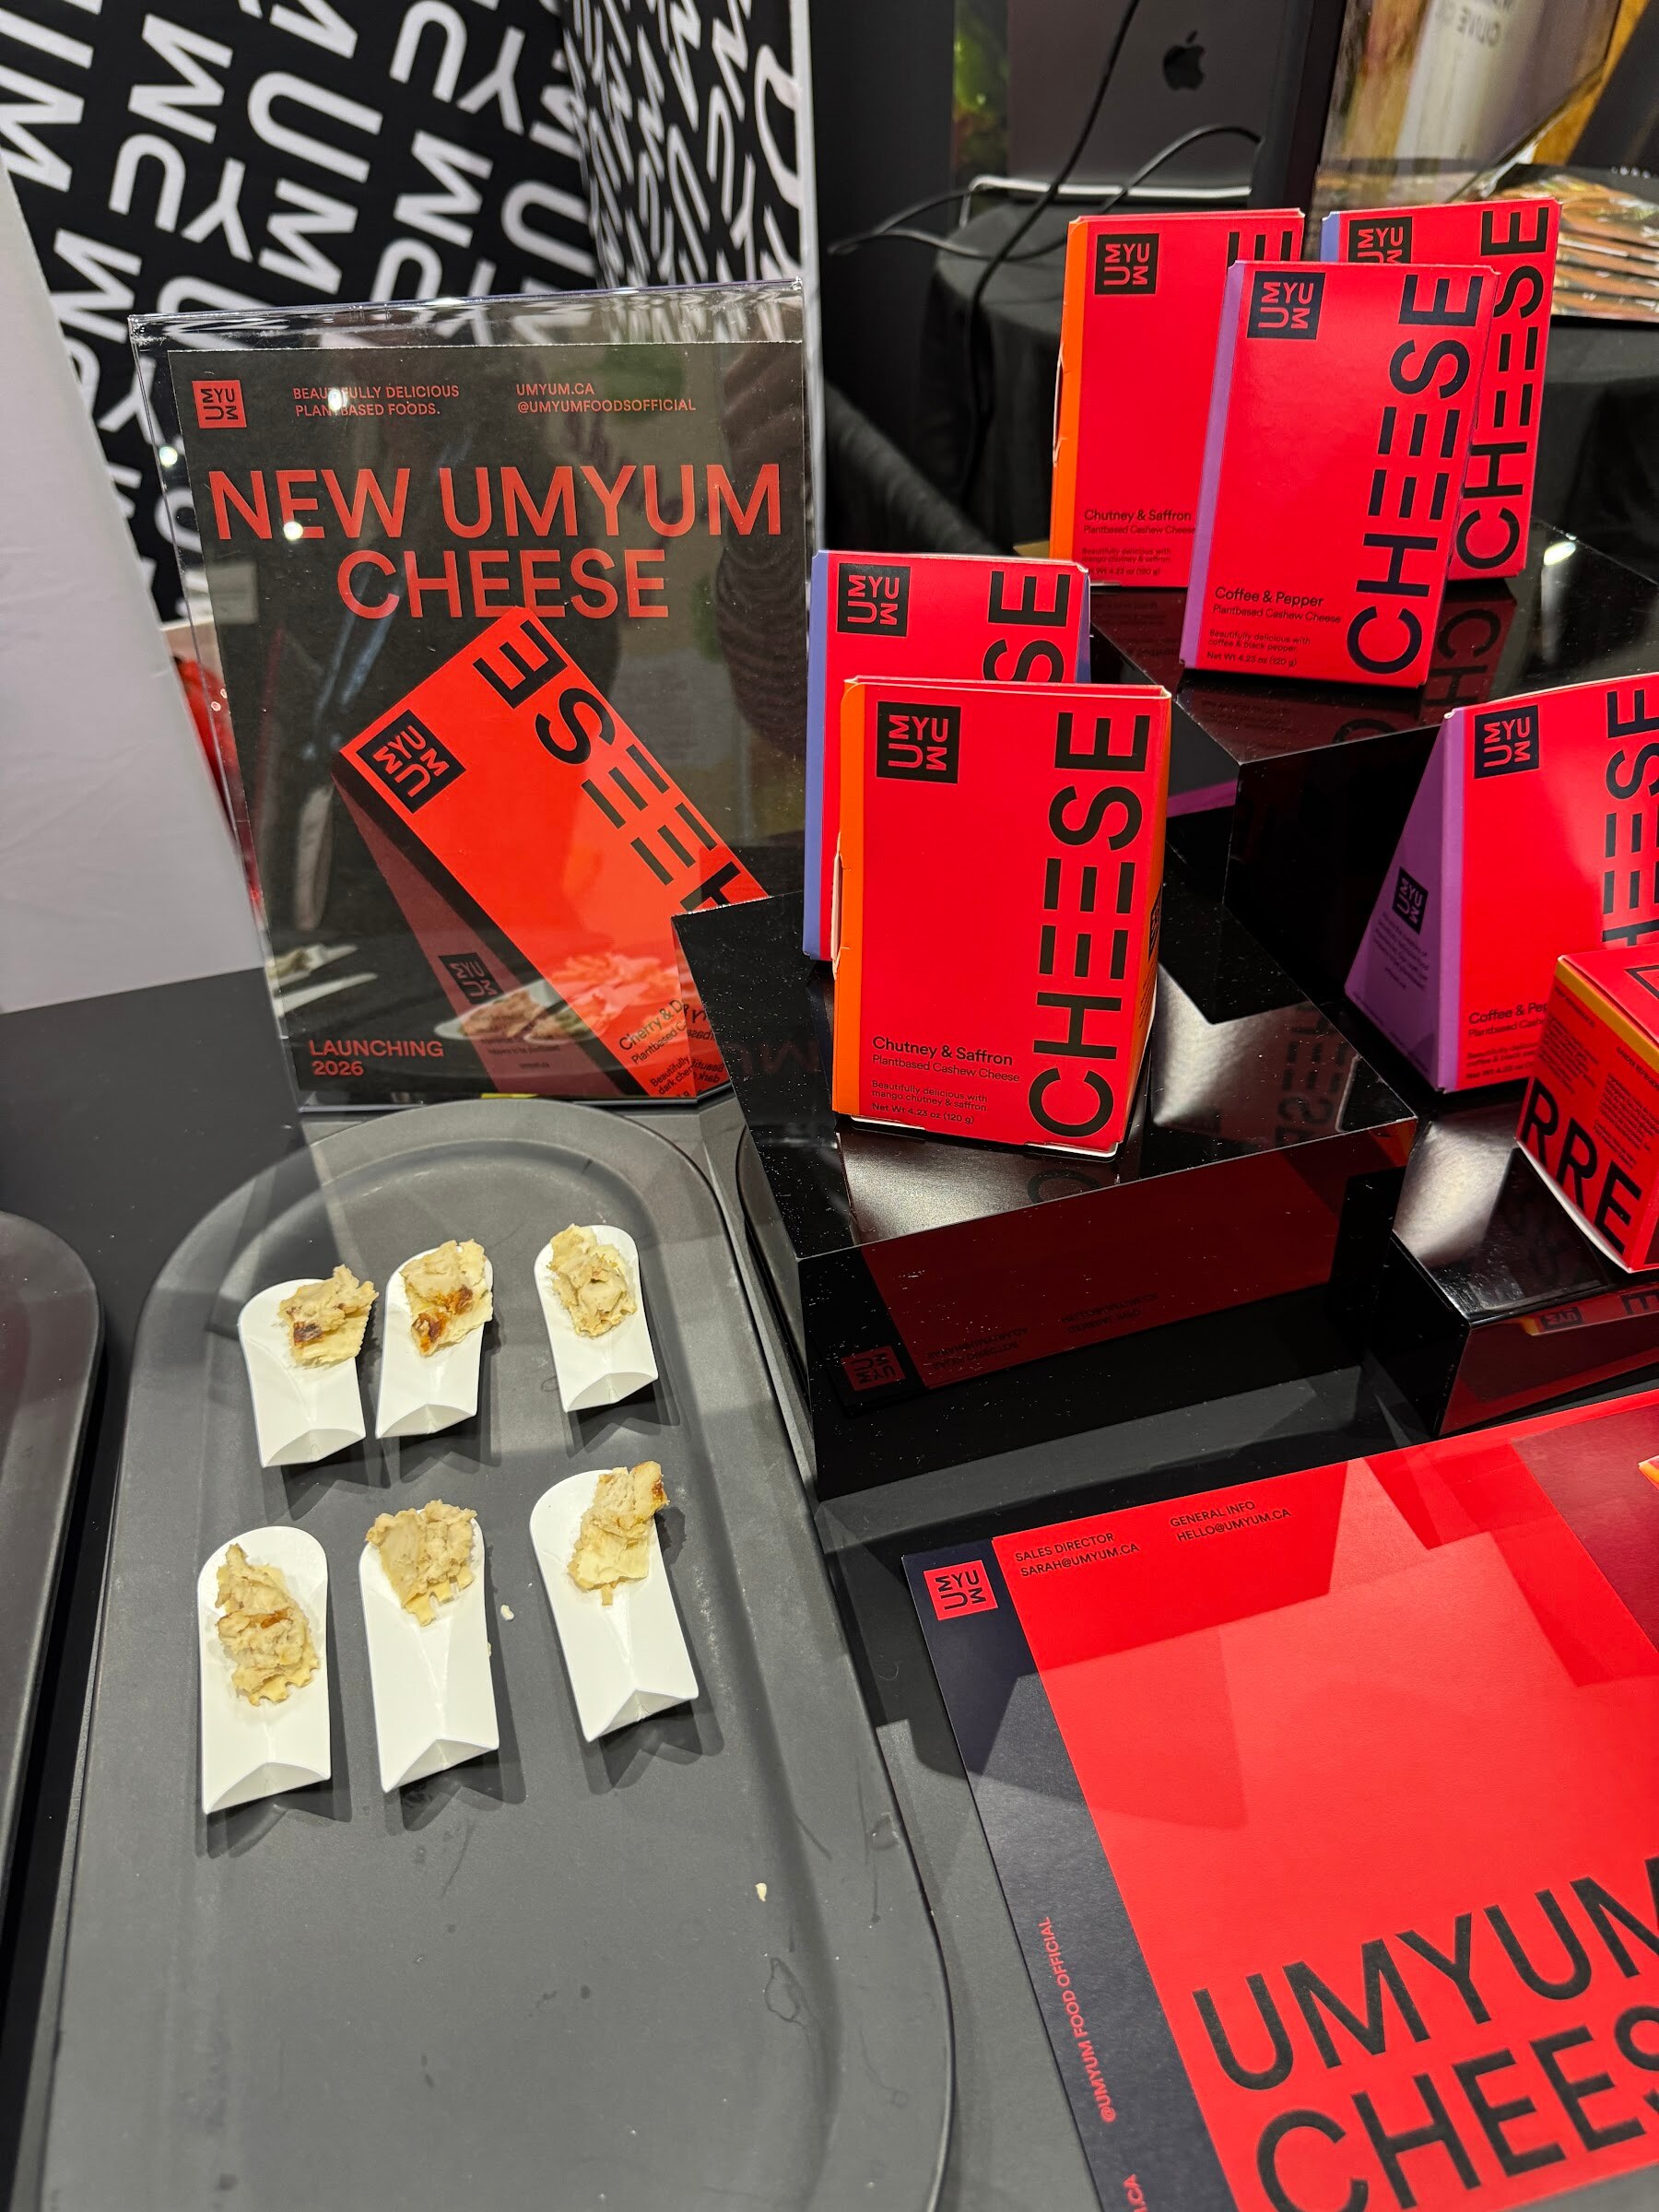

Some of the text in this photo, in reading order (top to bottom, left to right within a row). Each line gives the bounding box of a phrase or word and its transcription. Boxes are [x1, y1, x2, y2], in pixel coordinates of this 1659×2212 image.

[293, 385, 459, 400] BEAUFULLY DELICIOUS
[516, 383, 594, 396] UMYUM.CA
[296, 403, 441, 417] PLANBASED FOODS.
[518, 399, 696, 413] @UMYUMFOODSOFFICIAL
[1347, 274, 1480, 676] CHEESE
[208, 464, 781, 540] NEW UMYUM
[1084, 509, 1192, 523] Chutney & Saffron
[337, 548, 669, 618] CHEESE
[1215, 586, 1324, 608] Coffee & Pepper
[1213, 605, 1341, 623] Plantbased Cashew Cheese
[1030, 712, 1151, 1138] CHEESE
[1468, 1009, 1512, 1024] Coffee
[1515, 1004, 1524, 1016] &
[619, 1017, 663, 1052] Cherry
[658, 1008, 674, 1021] &
[309, 1040, 444, 1057] LAUNCHING
[631, 1030, 677, 1065] Plantbased
[872, 1036, 1013, 1065] Chutney & Saffron
[312, 1060, 364, 1077] 2026
[650, 1055, 691, 1087] Beautifully
[872, 1054, 1020, 1082] Plantbased Cashew Cheese
[658, 1079, 676, 1096] dark
[872, 1080, 988, 1103] Beautifully delicious with
[872, 1090, 903, 1101] mango
[906, 1093, 942, 1107] chutney
[945, 1099, 952, 1107] &
[872, 1102, 889, 1112] Net
[891, 1104, 905, 1114] Wt
[908, 1108, 928, 1117] 4.23
[943, 1112, 962, 1123] (120
[965, 1115, 974, 1125] g)
[1170, 1500, 1256, 1528] GENERAL INFO
[1176, 1509, 1292, 1542] HELLO@UMYUM.CA
[1016, 1532, 1114, 1563] SALES DIRECTOR
[1020, 1543, 1141, 1577] SARAH@UMYUM.CA
[1038, 1916, 1117, 2124] @UMYUM FOOD OFFICIAL
[1256, 2005, 1659, 2212] CHEES
